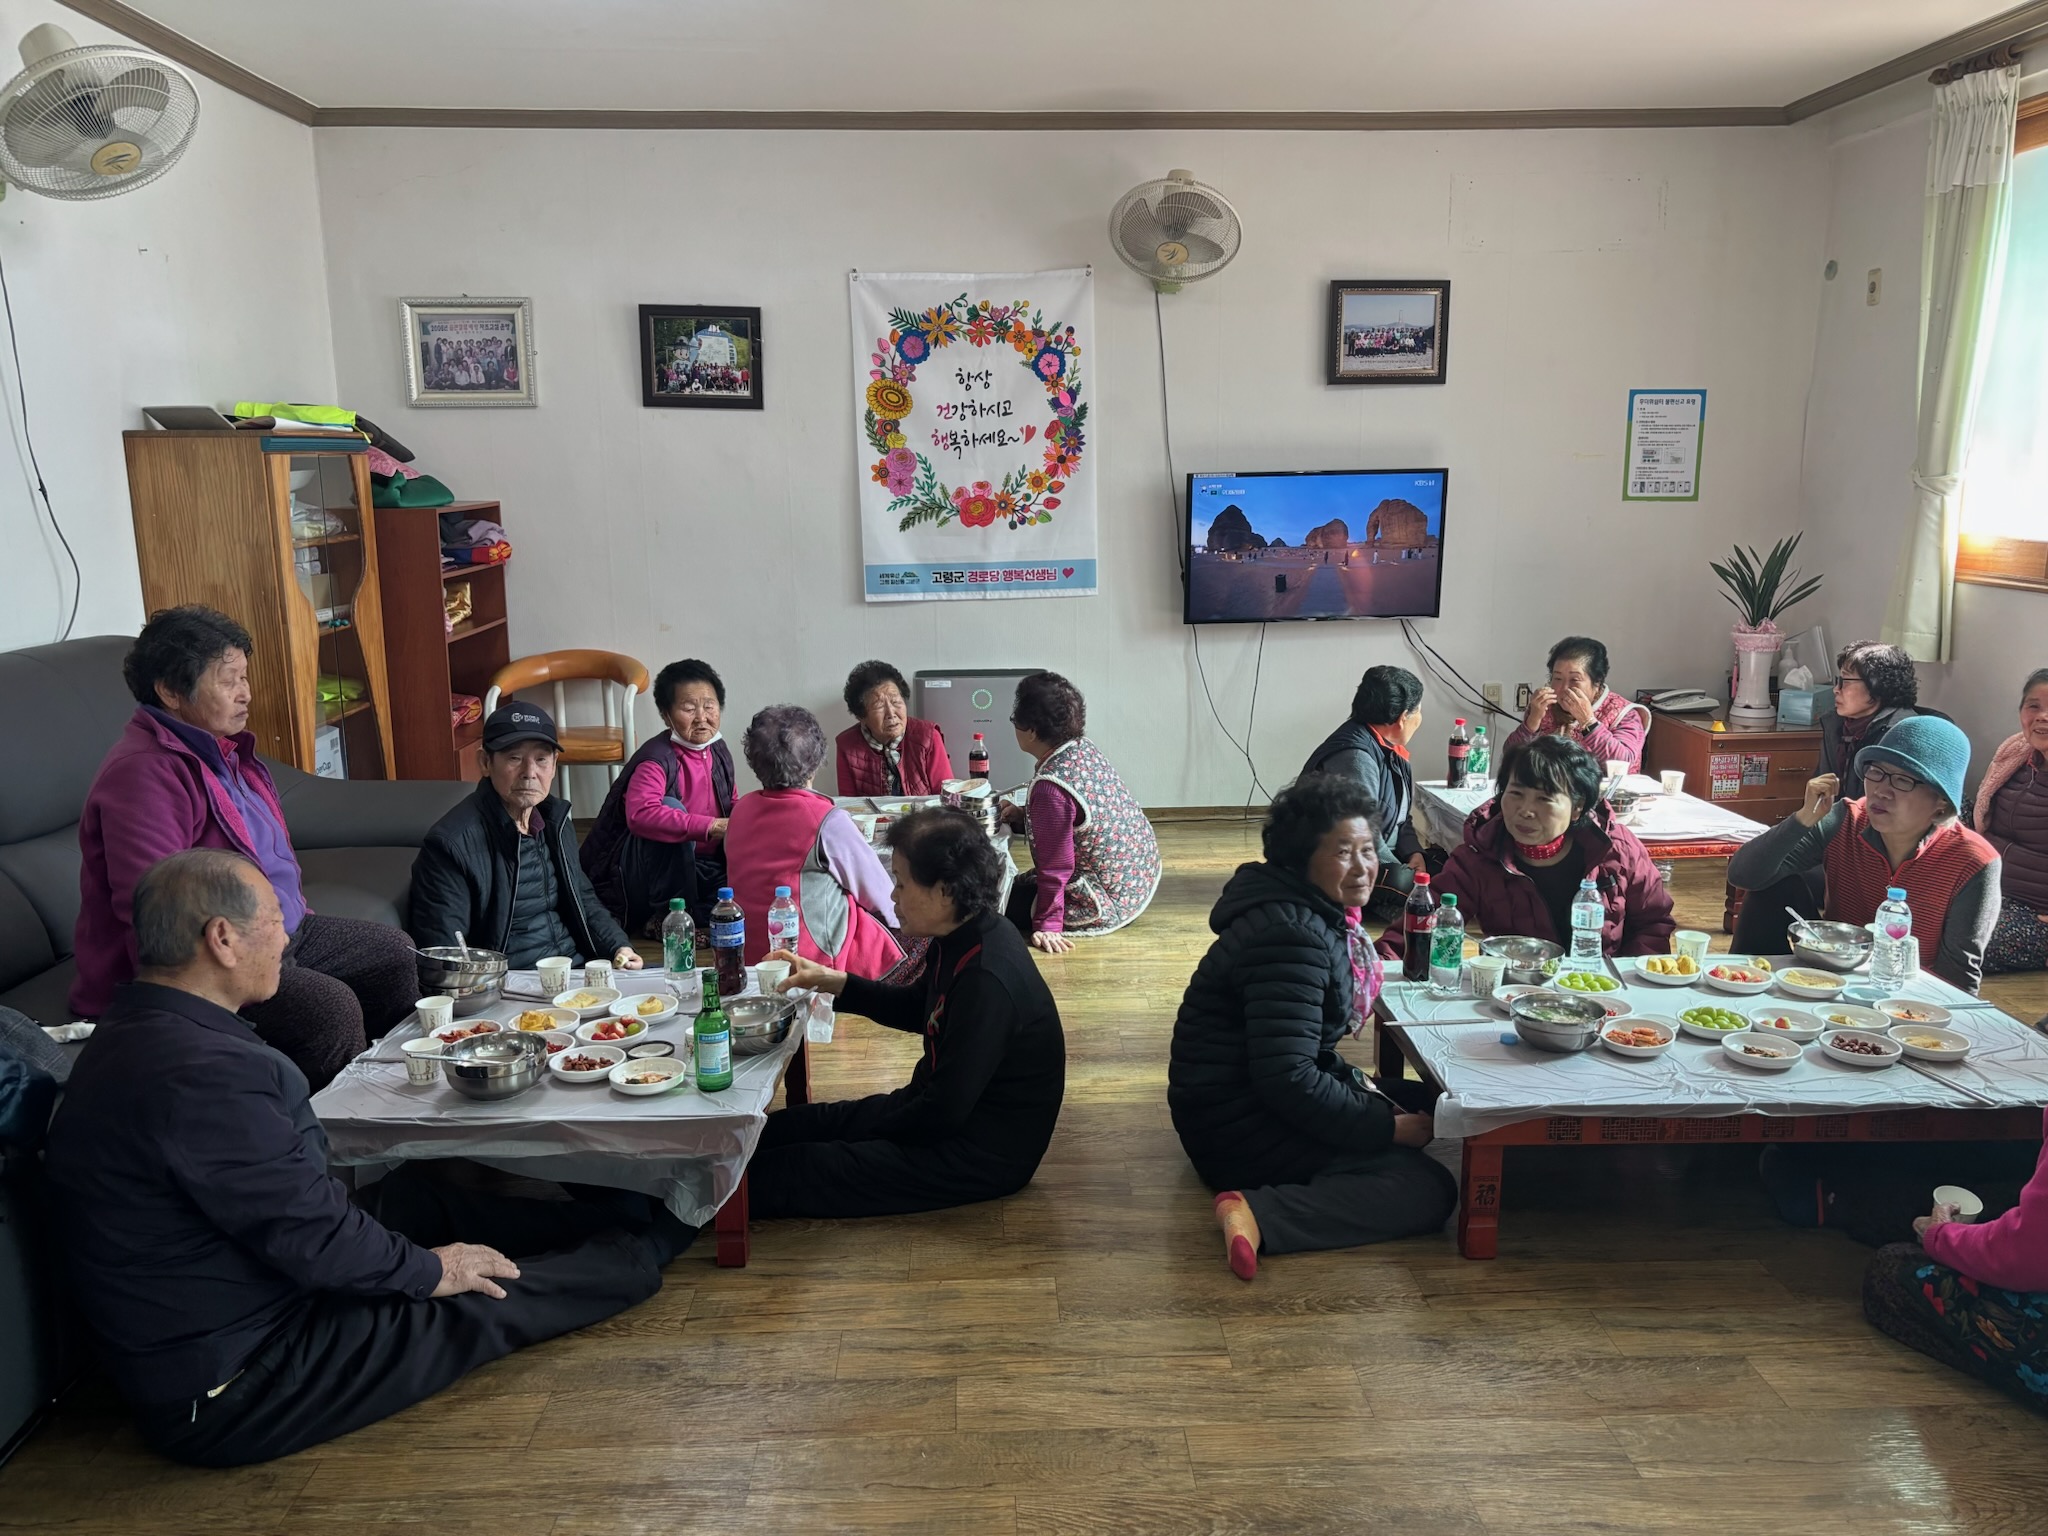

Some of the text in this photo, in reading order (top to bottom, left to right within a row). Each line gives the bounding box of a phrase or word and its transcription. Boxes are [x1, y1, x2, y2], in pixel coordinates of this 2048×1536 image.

[955, 367, 993, 392] 항상
[936, 399, 1014, 421] 건강하시고
[1665, 398, 1685, 406] 불편신고
[931, 568, 1057, 584] 고령군 경로당 행복선생님
